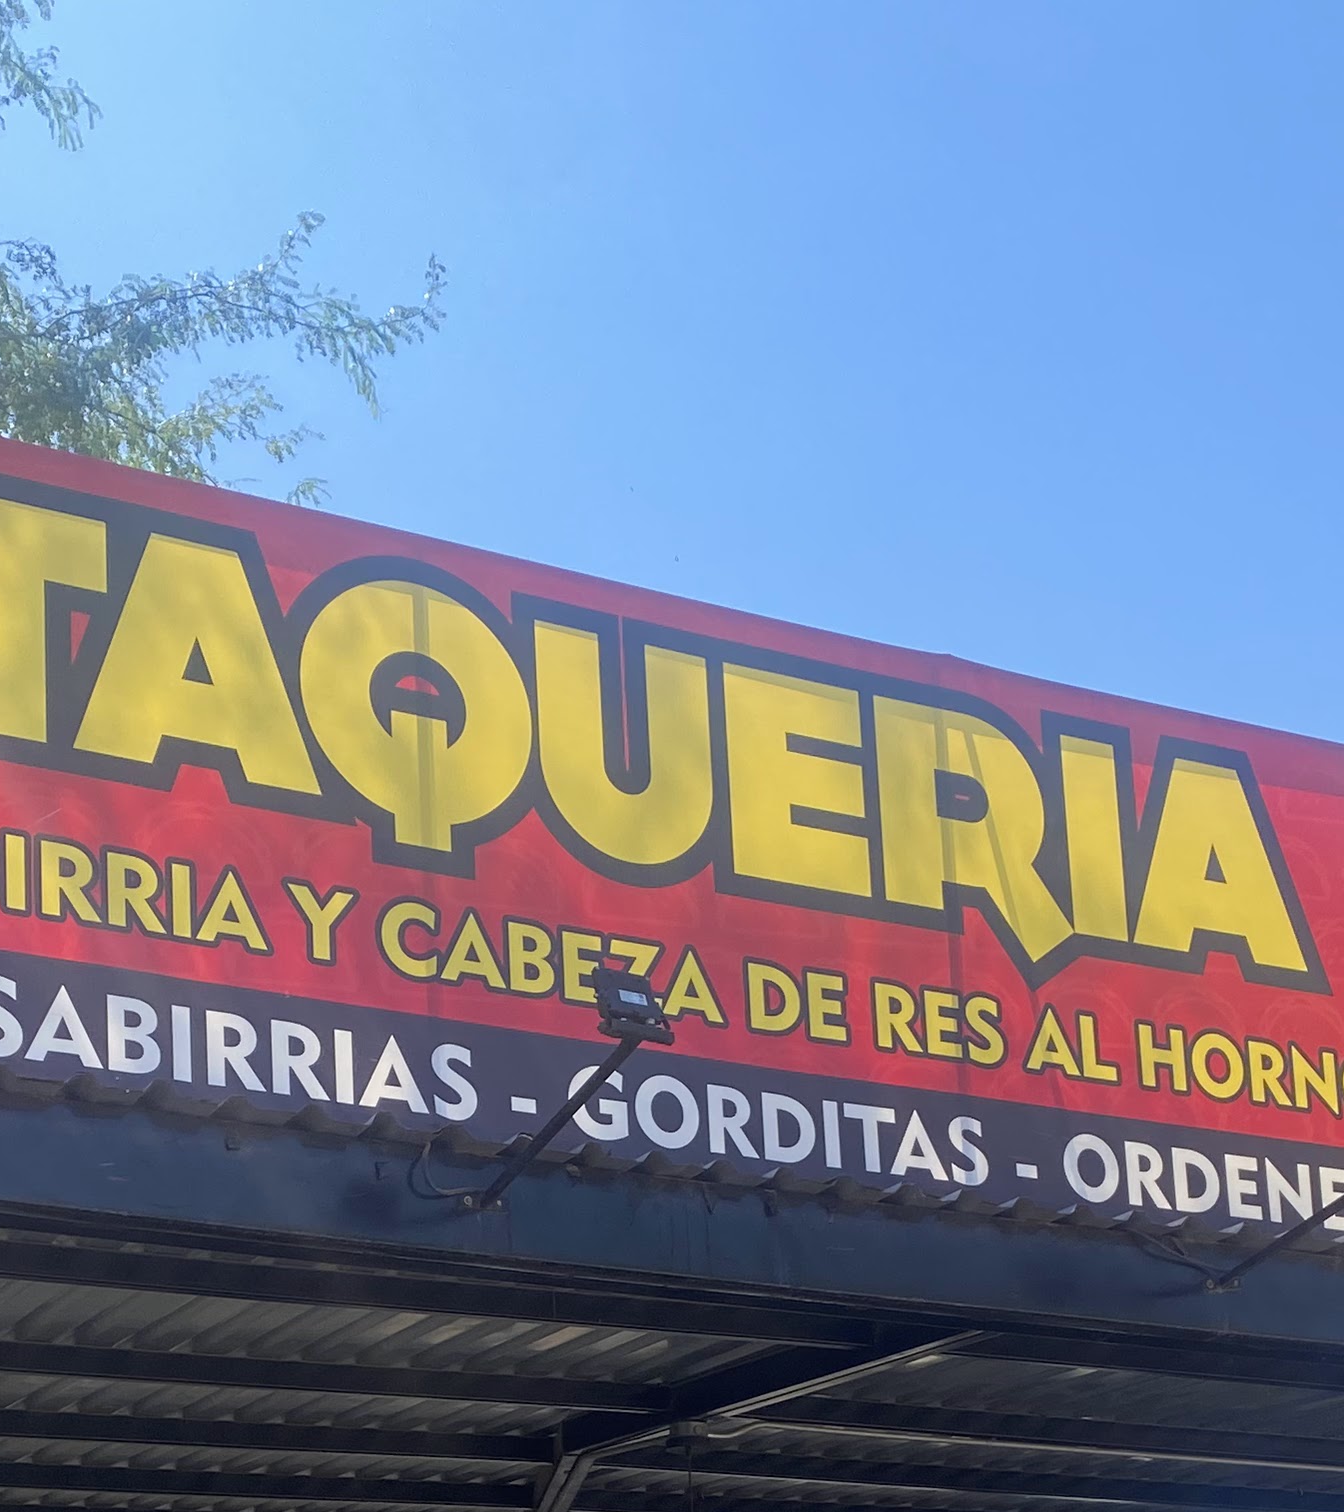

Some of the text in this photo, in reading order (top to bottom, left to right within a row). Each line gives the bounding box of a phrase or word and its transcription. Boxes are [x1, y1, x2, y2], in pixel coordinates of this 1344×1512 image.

[289, 880, 355, 962] Y
[750, 961, 848, 1043] DE
[874, 981, 1004, 1066] RES
[1026, 1007, 1119, 1082] AL
[511, 1096, 538, 1115] -
[567, 1065, 989, 1187] GORDITAS
[1015, 1162, 1038, 1180] -
